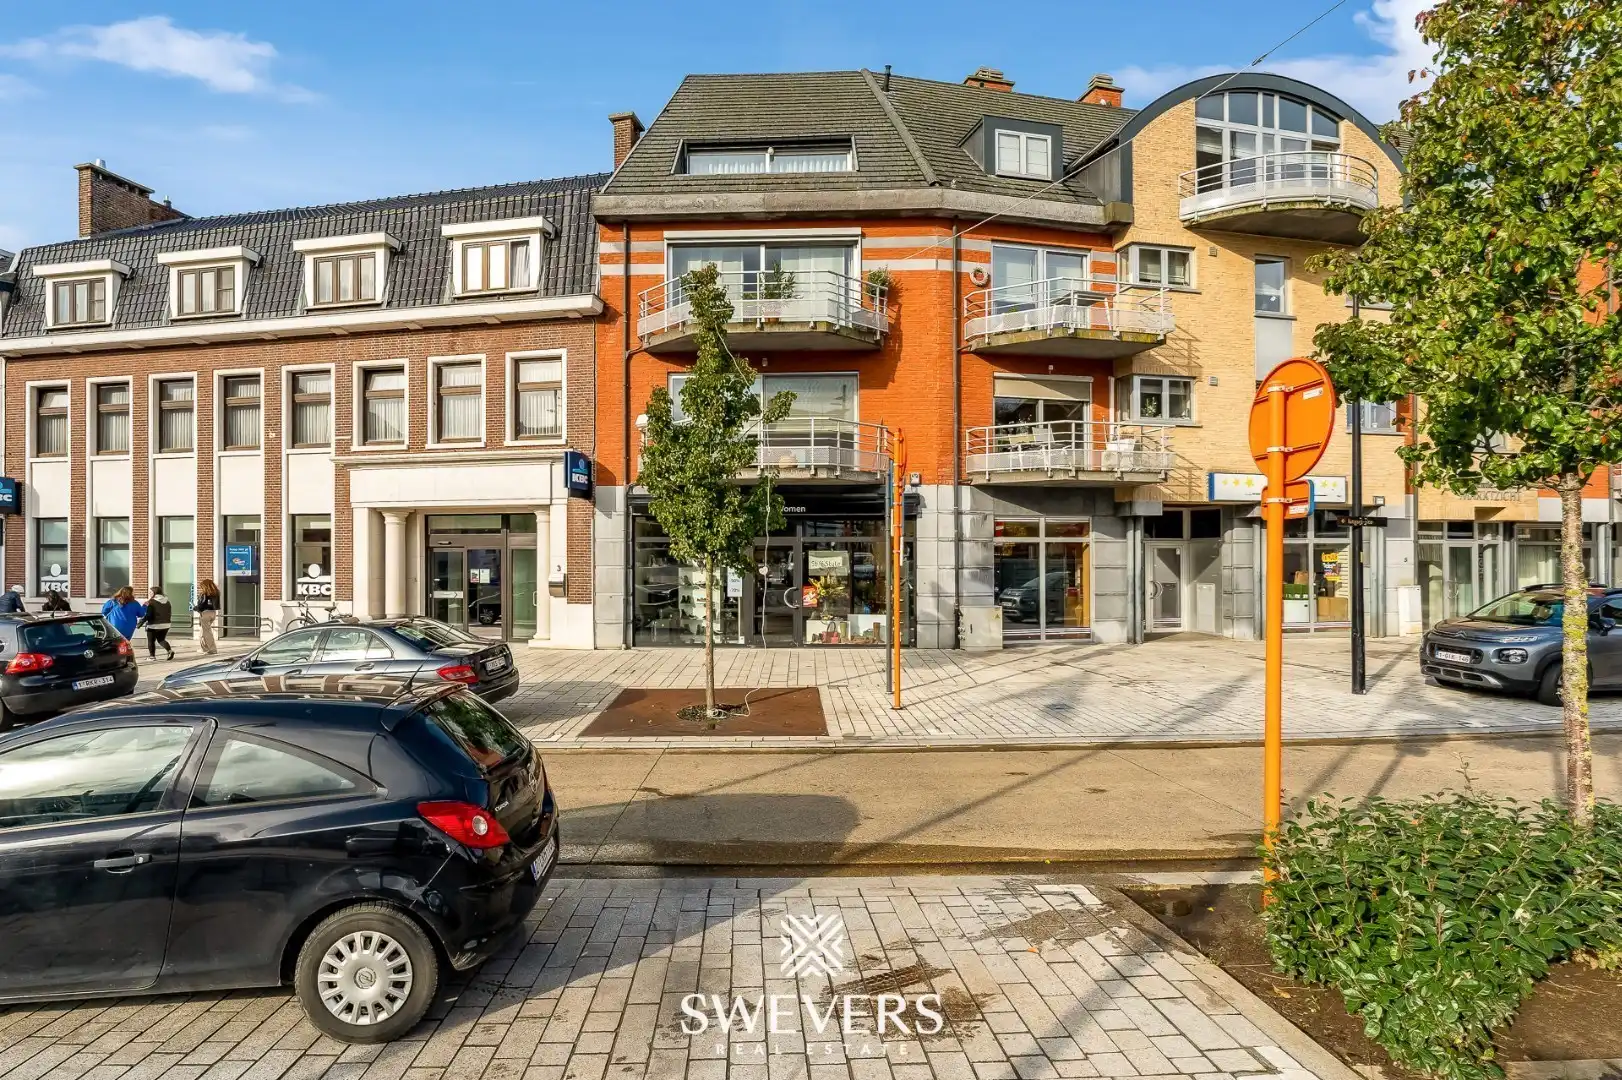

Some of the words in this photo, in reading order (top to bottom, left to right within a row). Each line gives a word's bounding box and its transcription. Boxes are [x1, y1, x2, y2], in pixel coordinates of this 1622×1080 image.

[571, 472, 588, 484] KBC
[556, 564, 562, 572] 3
[297, 584, 331, 596] KBC
